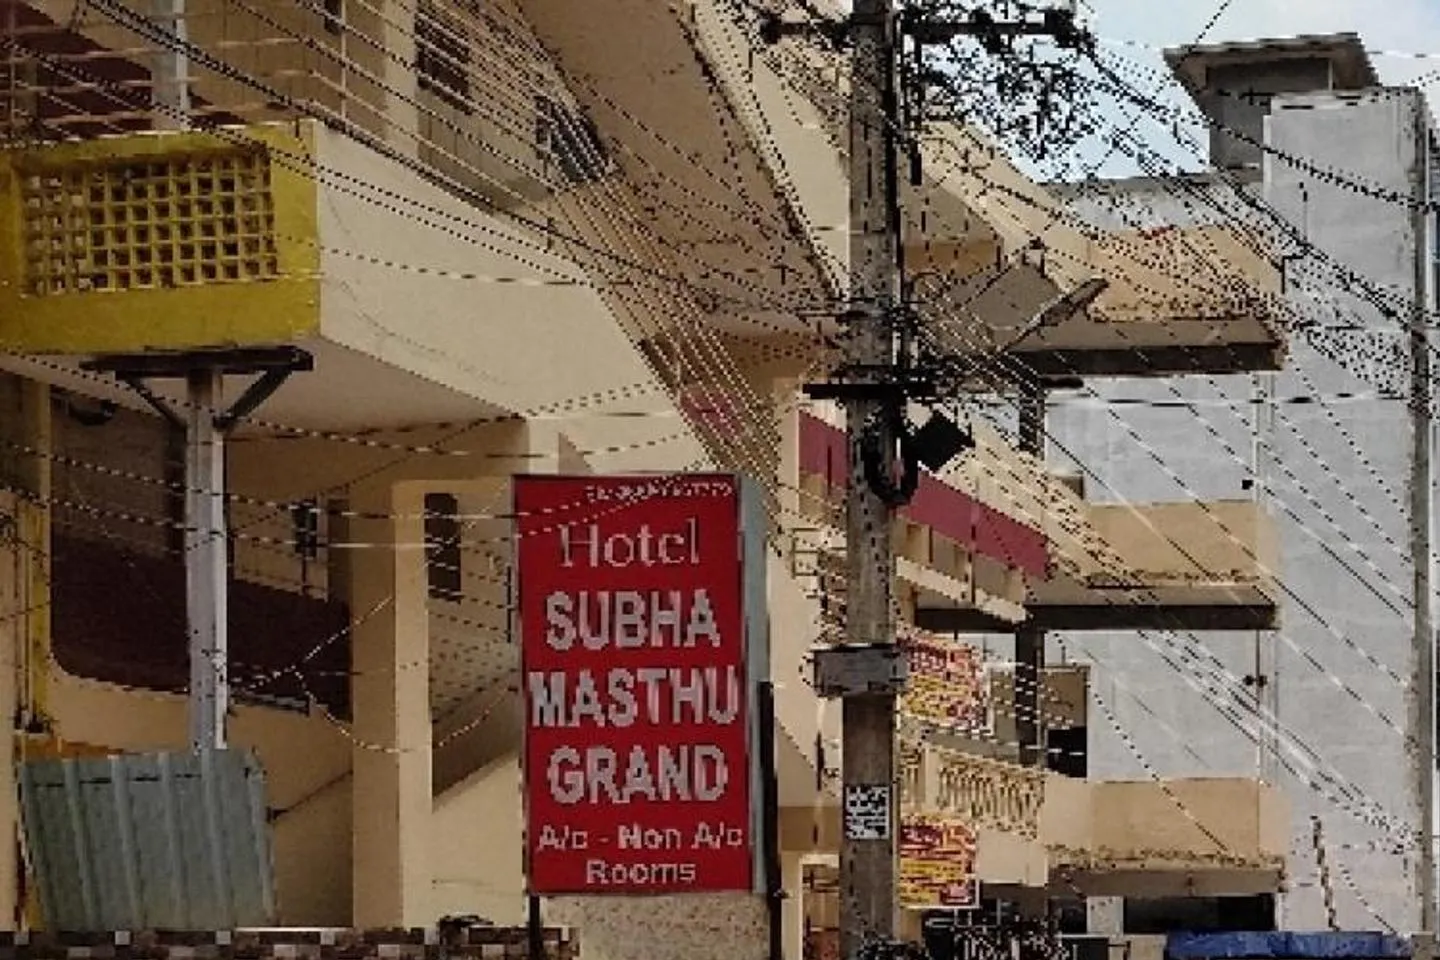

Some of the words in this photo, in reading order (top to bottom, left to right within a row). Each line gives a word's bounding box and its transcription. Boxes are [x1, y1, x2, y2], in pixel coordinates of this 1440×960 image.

[558, 516, 700, 568] Hotel
[545, 588, 721, 651] SUBHA
[528, 664, 739, 728] MASTHU
[546, 743, 729, 805] GRAND
[538, 823, 589, 851] A/c
[617, 823, 682, 850] Non
[691, 820, 743, 850] A/c
[586, 860, 696, 886] Rooms
